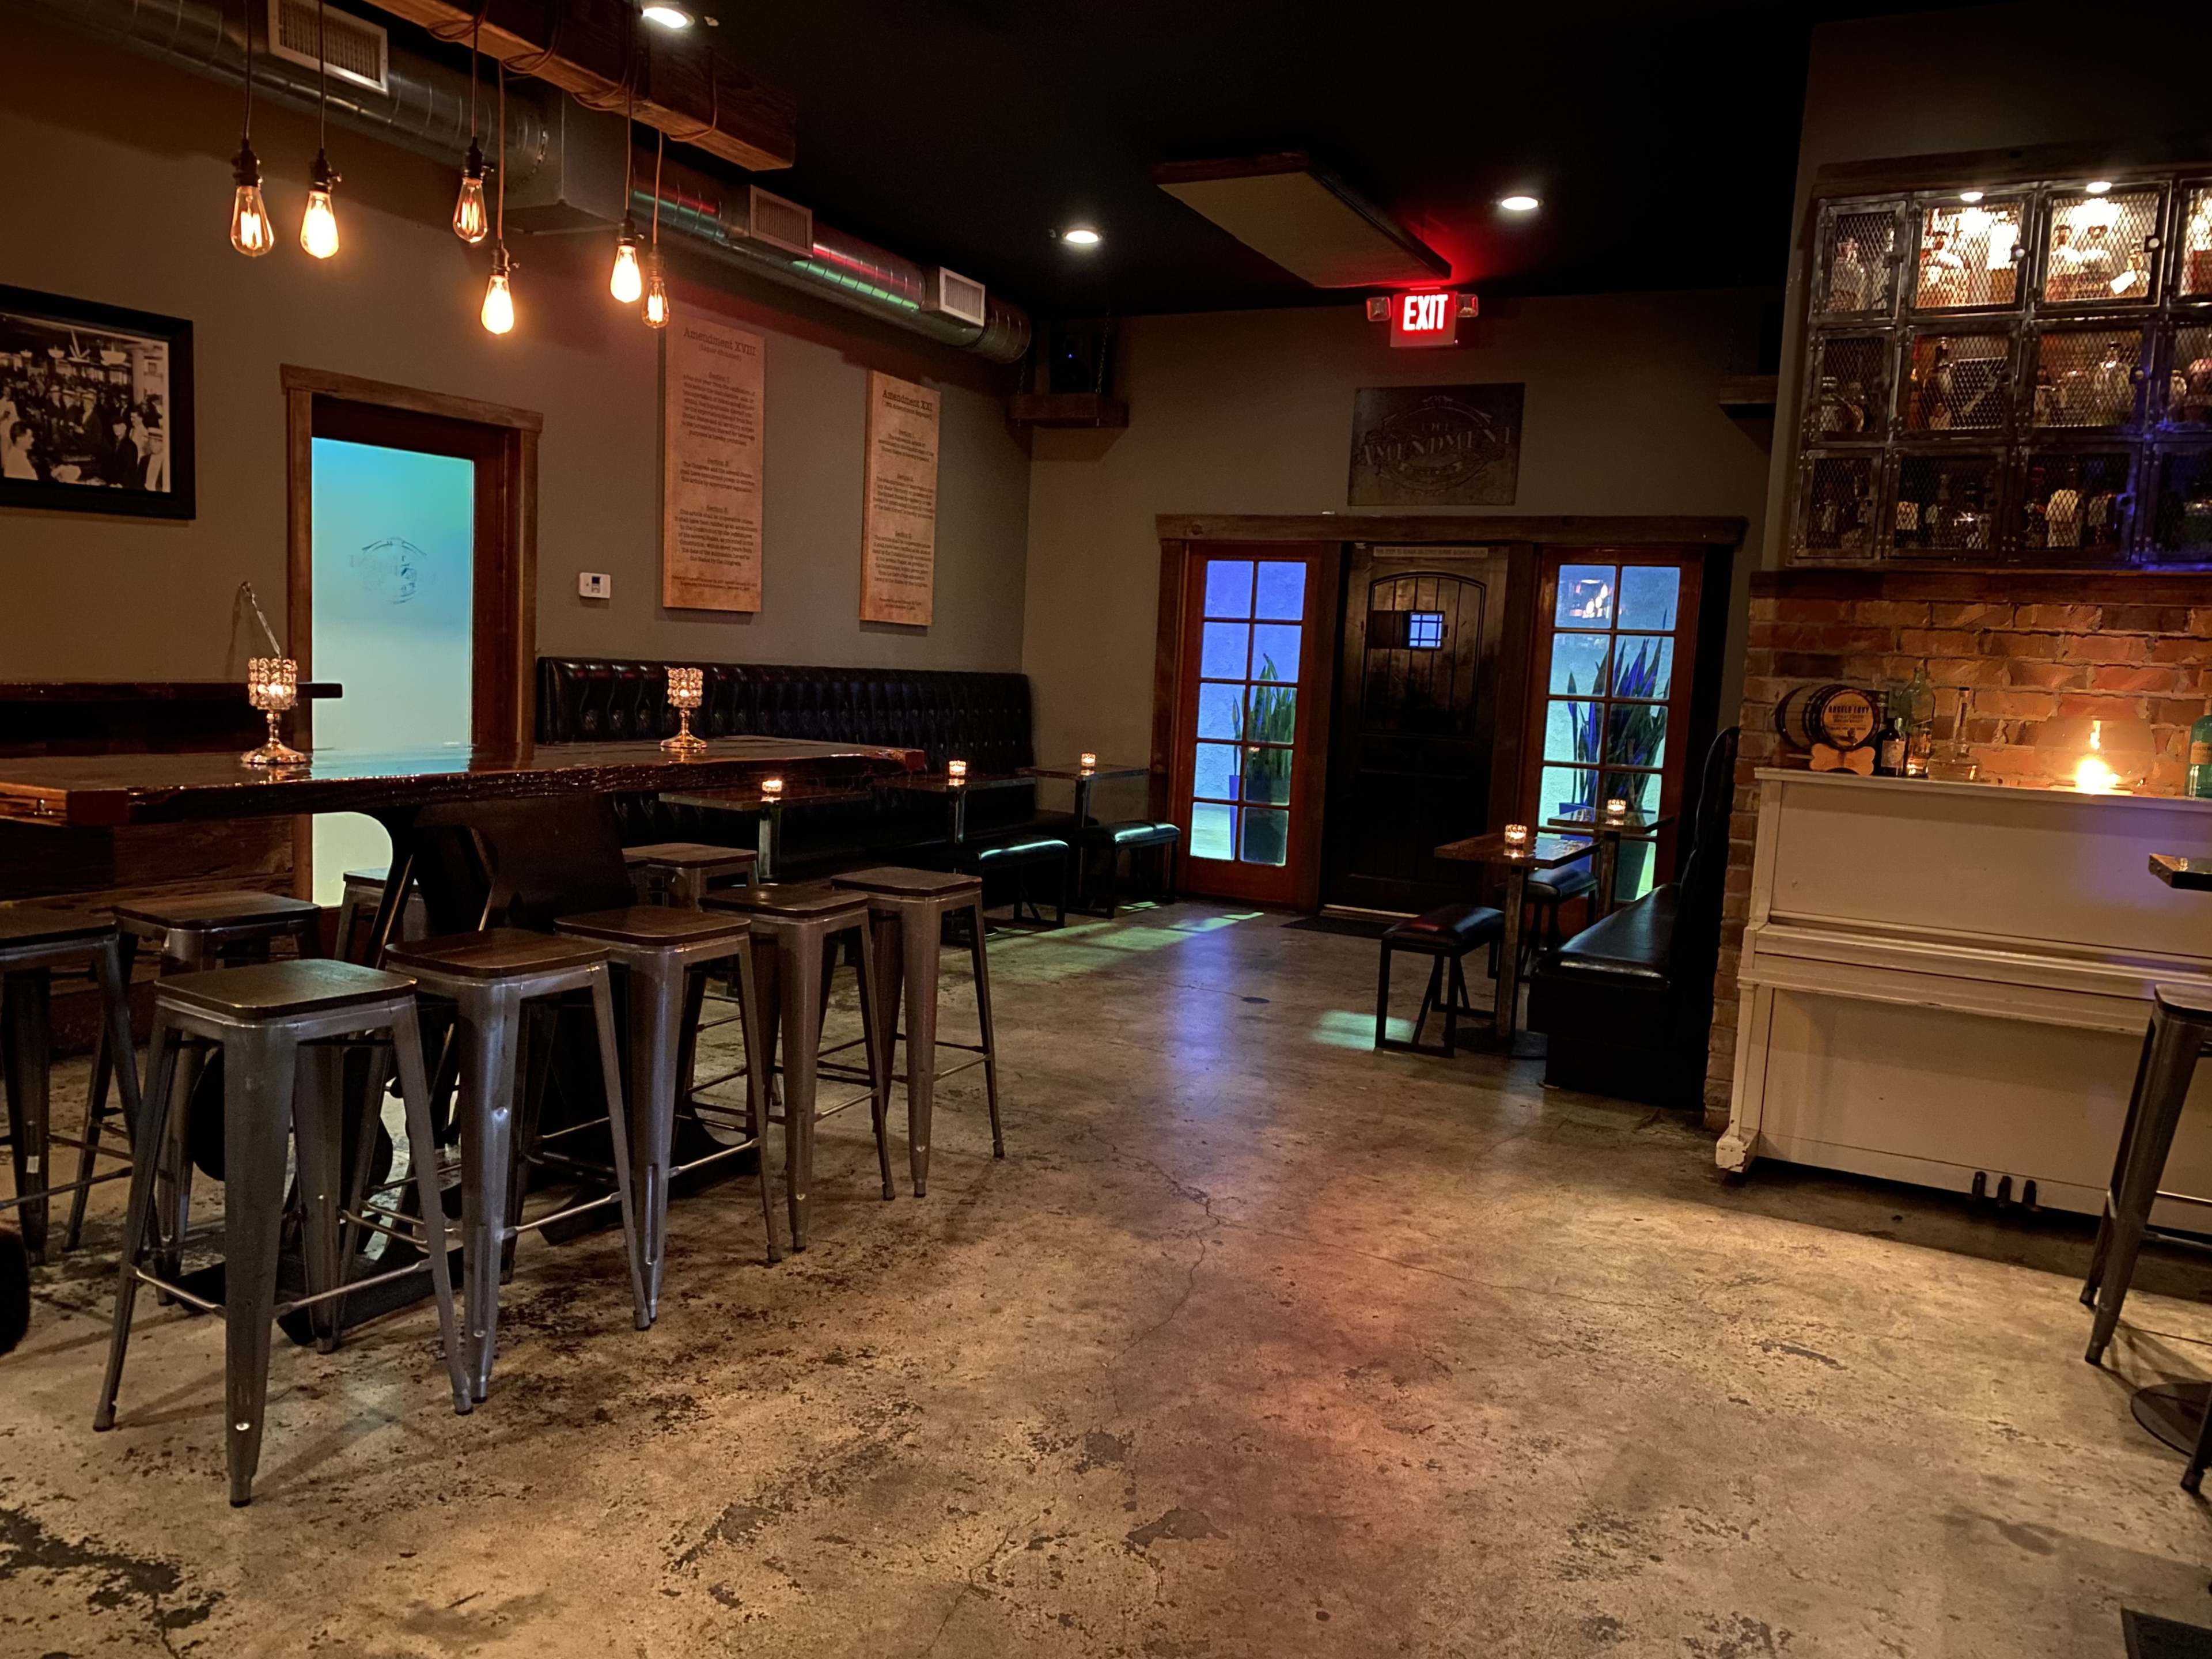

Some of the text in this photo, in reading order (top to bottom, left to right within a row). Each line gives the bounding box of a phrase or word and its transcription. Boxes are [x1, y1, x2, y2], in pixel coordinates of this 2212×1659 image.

[1403, 294, 1448, 331] EXIT
[683, 327, 756, 356] Amendment XVIII
[882, 389, 932, 412] Amendment XXI
[1362, 425, 1516, 465] AMENDMENT
